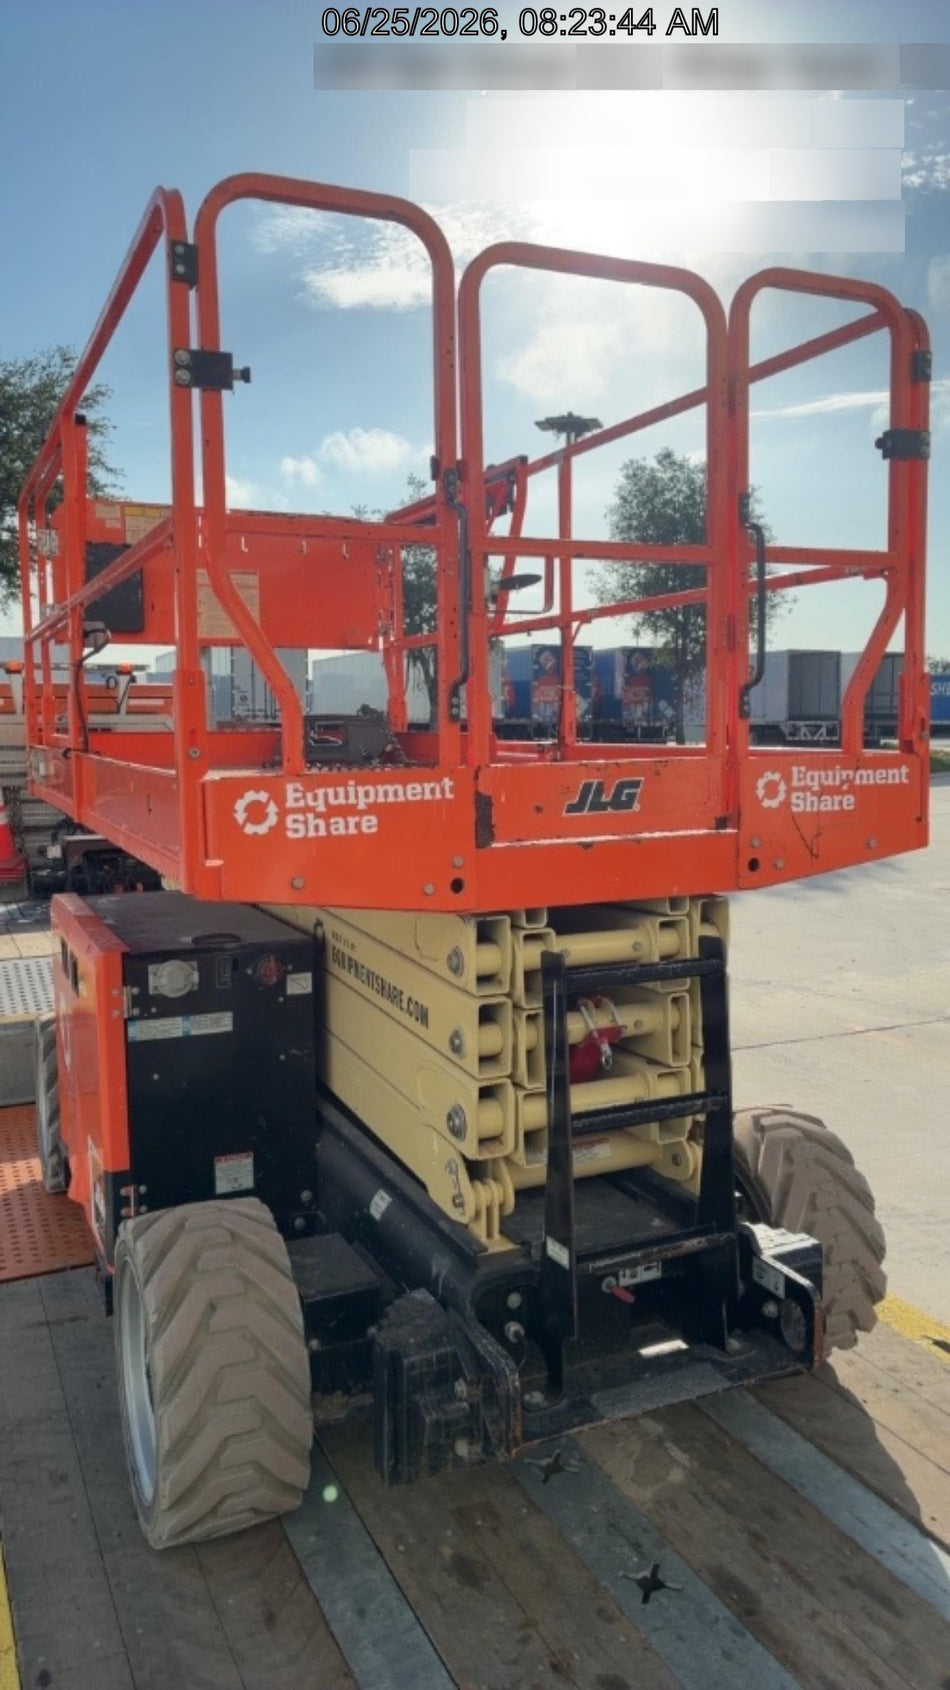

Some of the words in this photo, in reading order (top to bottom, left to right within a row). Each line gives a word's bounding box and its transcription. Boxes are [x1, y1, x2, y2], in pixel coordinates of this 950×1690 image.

[791, 764, 909, 791] Equipment
[285, 777, 454, 812] Equipment
[563, 777, 644, 815] JLG
[791, 791, 856, 812] Share
[285, 812, 378, 839] Share
